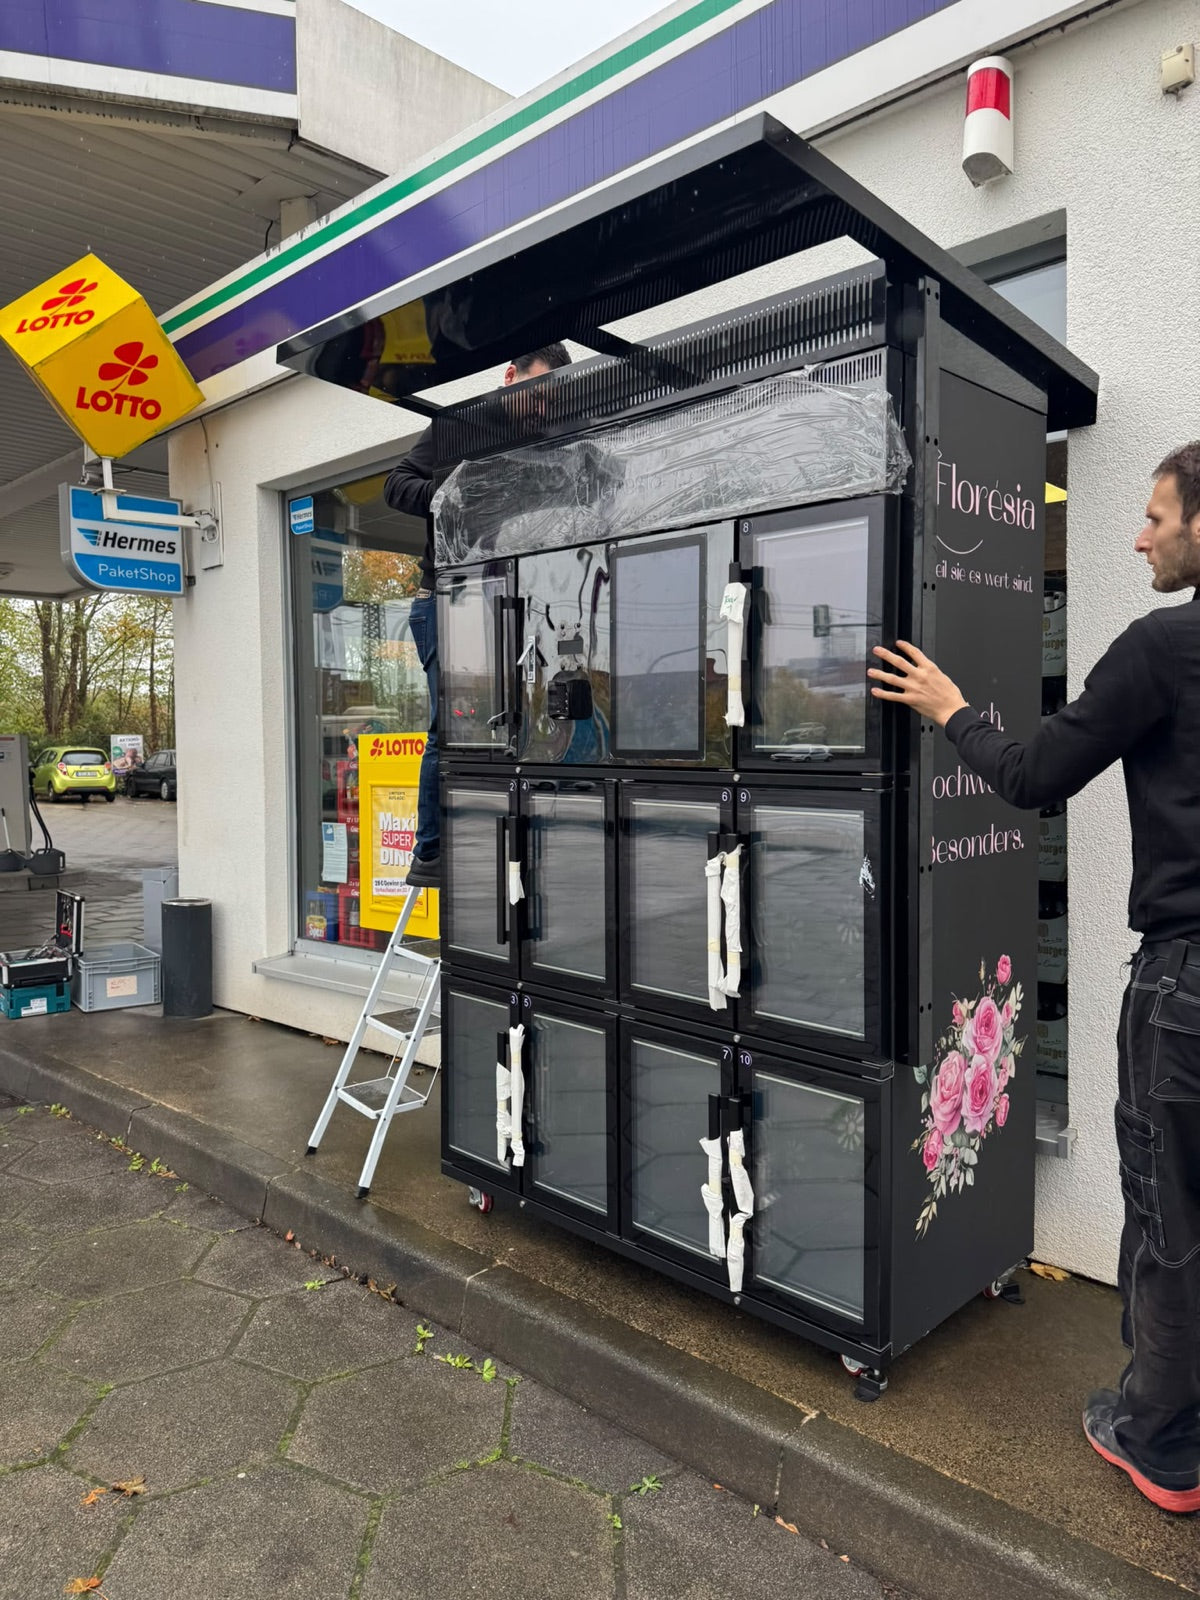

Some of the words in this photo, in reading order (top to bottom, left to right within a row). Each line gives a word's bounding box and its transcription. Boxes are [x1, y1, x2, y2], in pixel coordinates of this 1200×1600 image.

[15, 309, 95, 334] LOTTO
[76, 386, 162, 421] LOTTO
[742, 521, 750, 533] 8
[102, 530, 177, 555] Hermes
[98, 563, 176, 585] PaketShop
[935, 559, 948, 579] eil
[950, 562, 966, 582] sie
[969, 569, 982, 585] es
[985, 572, 1010, 590] wert
[386, 738, 425, 756] LOTTO
[932, 765, 996, 798] ochw
[721, 791, 728, 802] 6
[740, 791, 747, 803] 9
[379, 812, 415, 832] Maxi
[382, 832, 412, 847] SUPER
[510, 995, 516, 1005] 3
[523, 998, 529, 1007] 5
[722, 1049, 729, 1060] 7
[740, 1054, 751, 1066] 10
